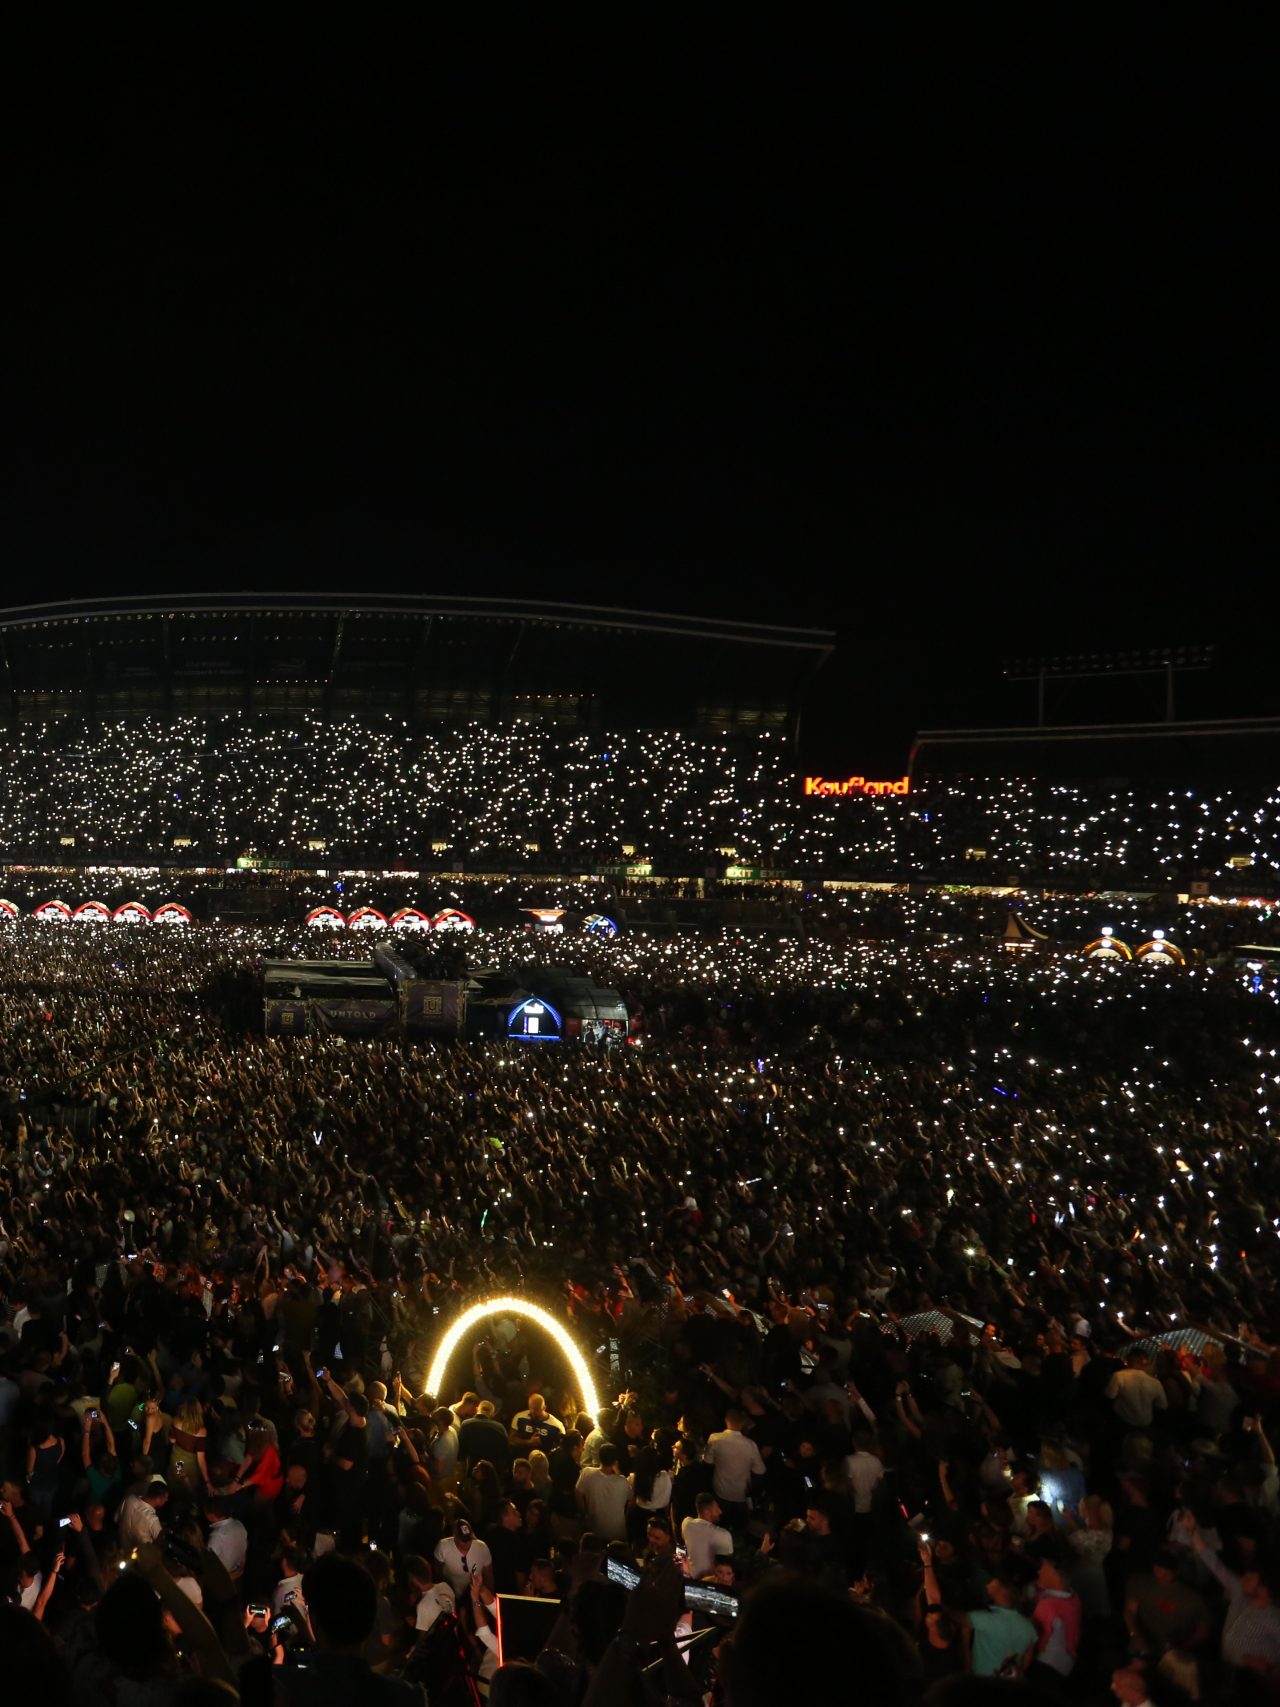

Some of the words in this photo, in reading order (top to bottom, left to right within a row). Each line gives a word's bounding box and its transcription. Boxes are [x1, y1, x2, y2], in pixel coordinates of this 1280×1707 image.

[240, 860, 263, 868] EXIT
[626, 866, 651, 875] EXIT
[727, 868, 753, 878] EXIT
[330, 1009, 377, 1020] UNTOLD
